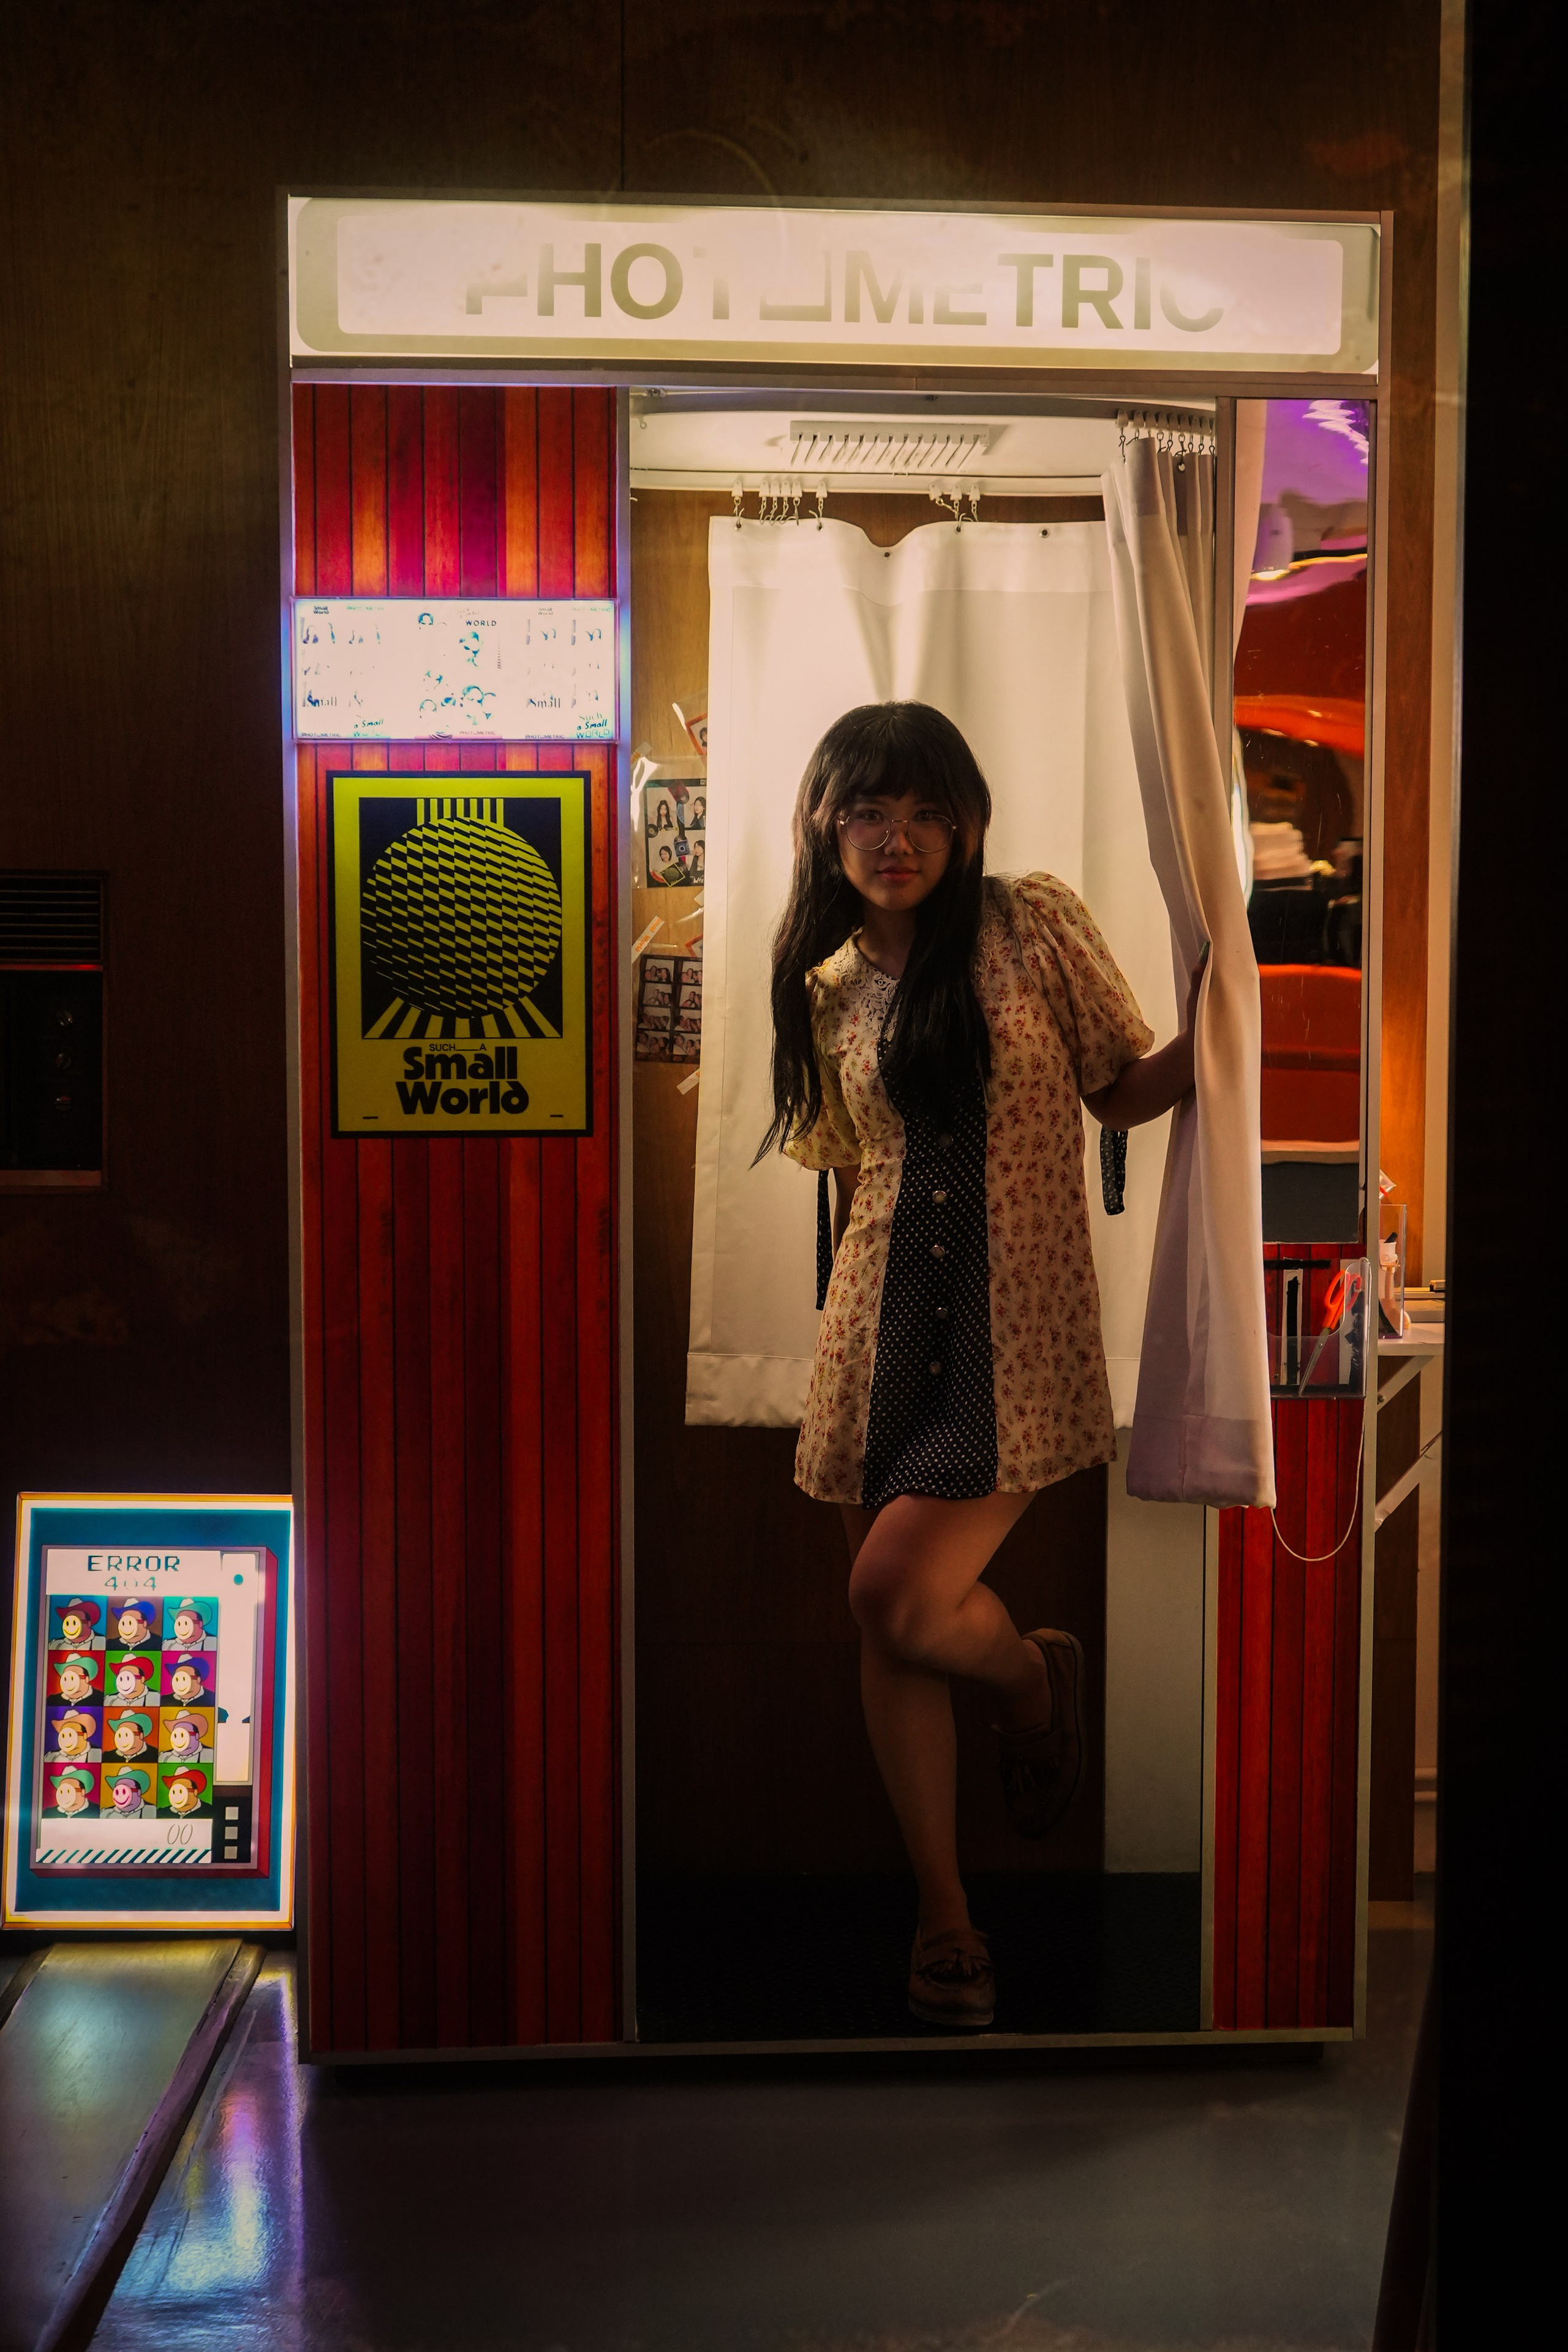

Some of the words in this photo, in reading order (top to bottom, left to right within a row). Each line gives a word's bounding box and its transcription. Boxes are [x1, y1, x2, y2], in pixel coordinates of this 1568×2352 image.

[362, 718, 384, 728] Small
[585, 718, 608, 729] Small
[576, 728, 610, 739] WORLD
[403, 1046, 518, 1080] Small
[395, 1081, 529, 1115] World
[87, 1555, 181, 1572] ERROR
